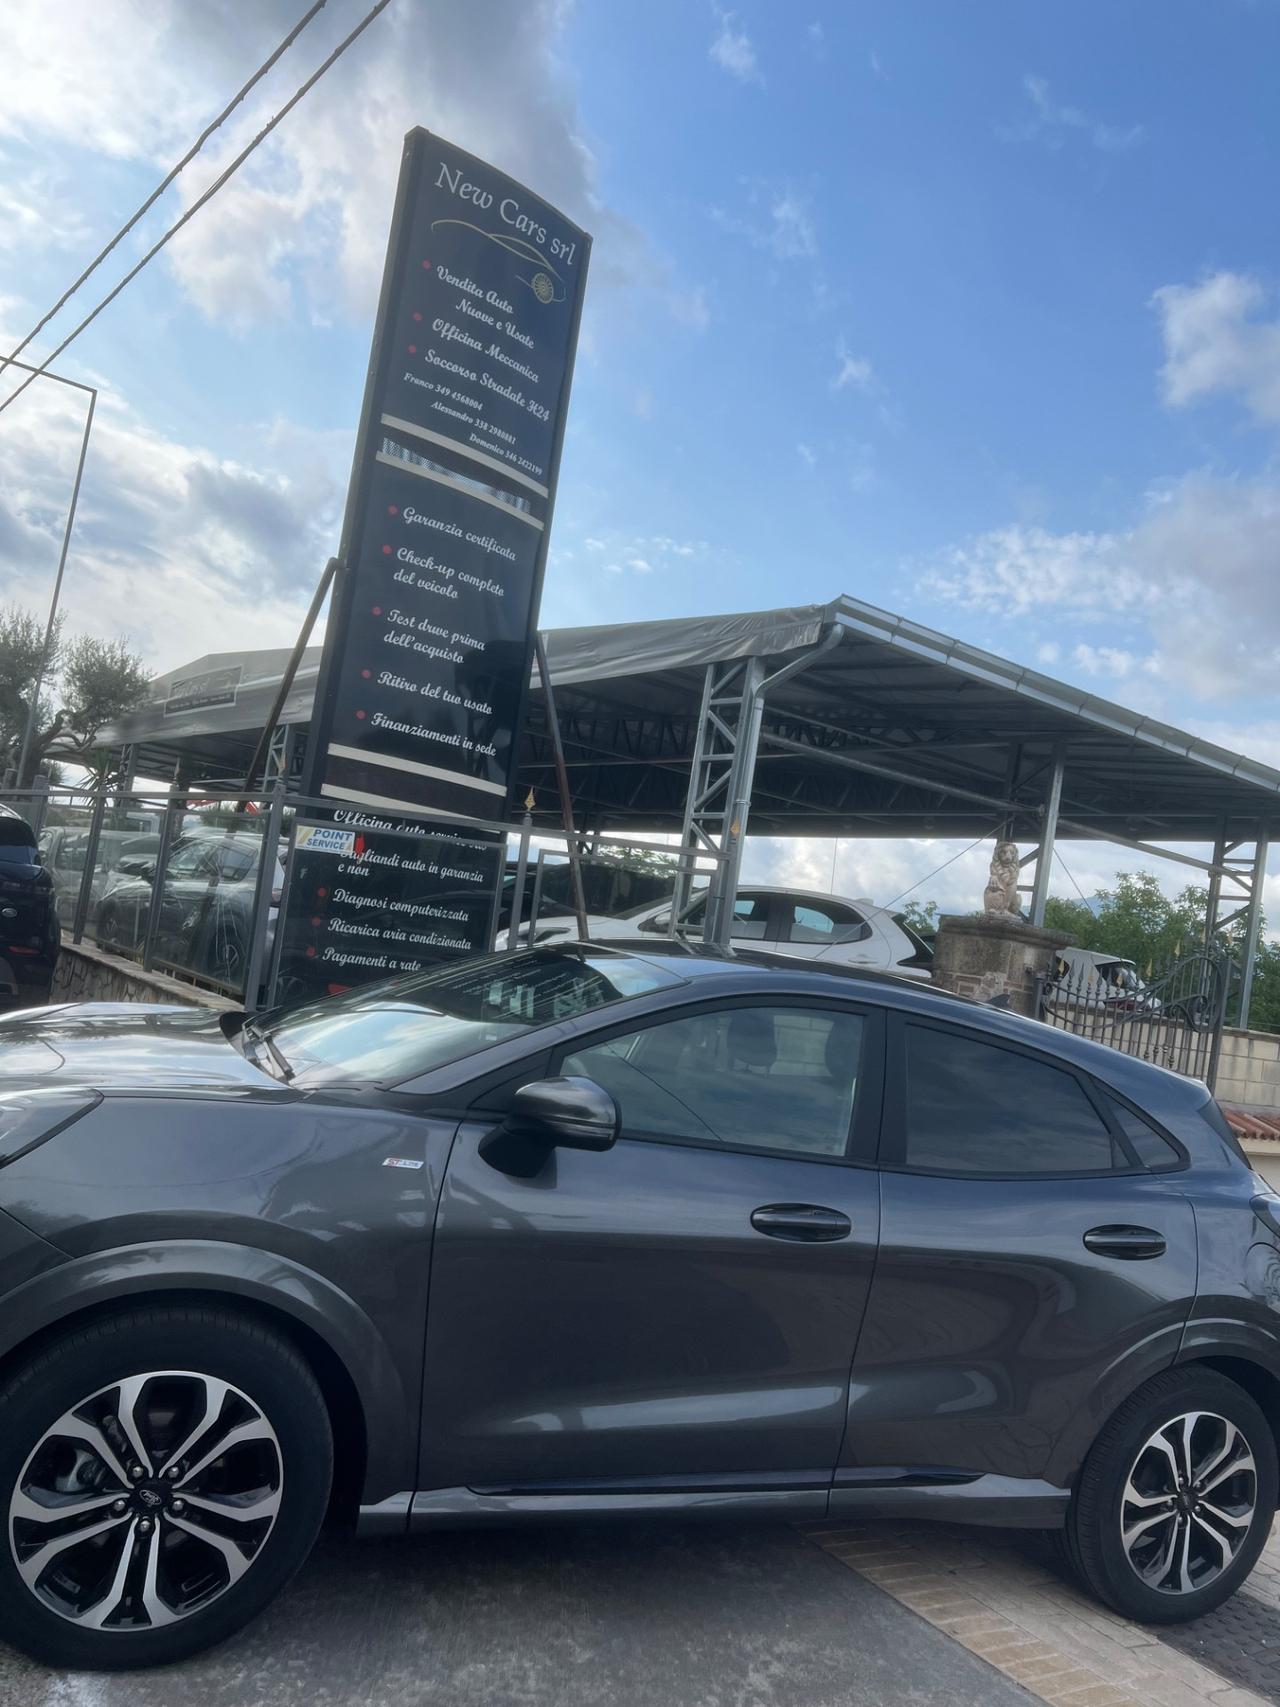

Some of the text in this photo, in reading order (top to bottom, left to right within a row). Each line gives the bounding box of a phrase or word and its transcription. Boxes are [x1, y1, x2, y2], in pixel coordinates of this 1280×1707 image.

[435, 162, 576, 265] New Cars srl
[437, 266, 514, 314] Vendita Auto
[456, 299, 535, 349] Nuove e Usate
[432, 318, 539, 383] Officina Meccanica
[403, 372, 433, 389] Franco
[435, 384, 450, 396] 349
[425, 350, 550, 422] Soccorso Stradale H24
[431, 402, 473, 423] Alessandro
[474, 419, 488, 430] 338
[470, 433, 504, 454] Domenico
[403, 507, 516, 561] Garanzia certificata
[394, 569, 459, 599] del veicolo
[397, 548, 504, 596] Check-up completo
[387, 609, 416, 628] Test
[450, 633, 486, 651] prima
[384, 631, 464, 664] dell'acquisto
[377, 672, 492, 714] Ritiro del tuo usato
[371, 712, 496, 756] Finanziamenti in sede
[313, 829, 352, 841] POINT
[334, 810, 392, 831] Officina
[307, 838, 346, 850] SERVICE
[338, 864, 369, 876] e non
[340, 849, 483, 882] agliandi auto in garanzia
[333, 888, 469, 922] Diagnosi computerizzata
[328, 918, 472, 950] Ricarica aria condizionata
[322, 947, 421, 971] Pagamenti a rate
